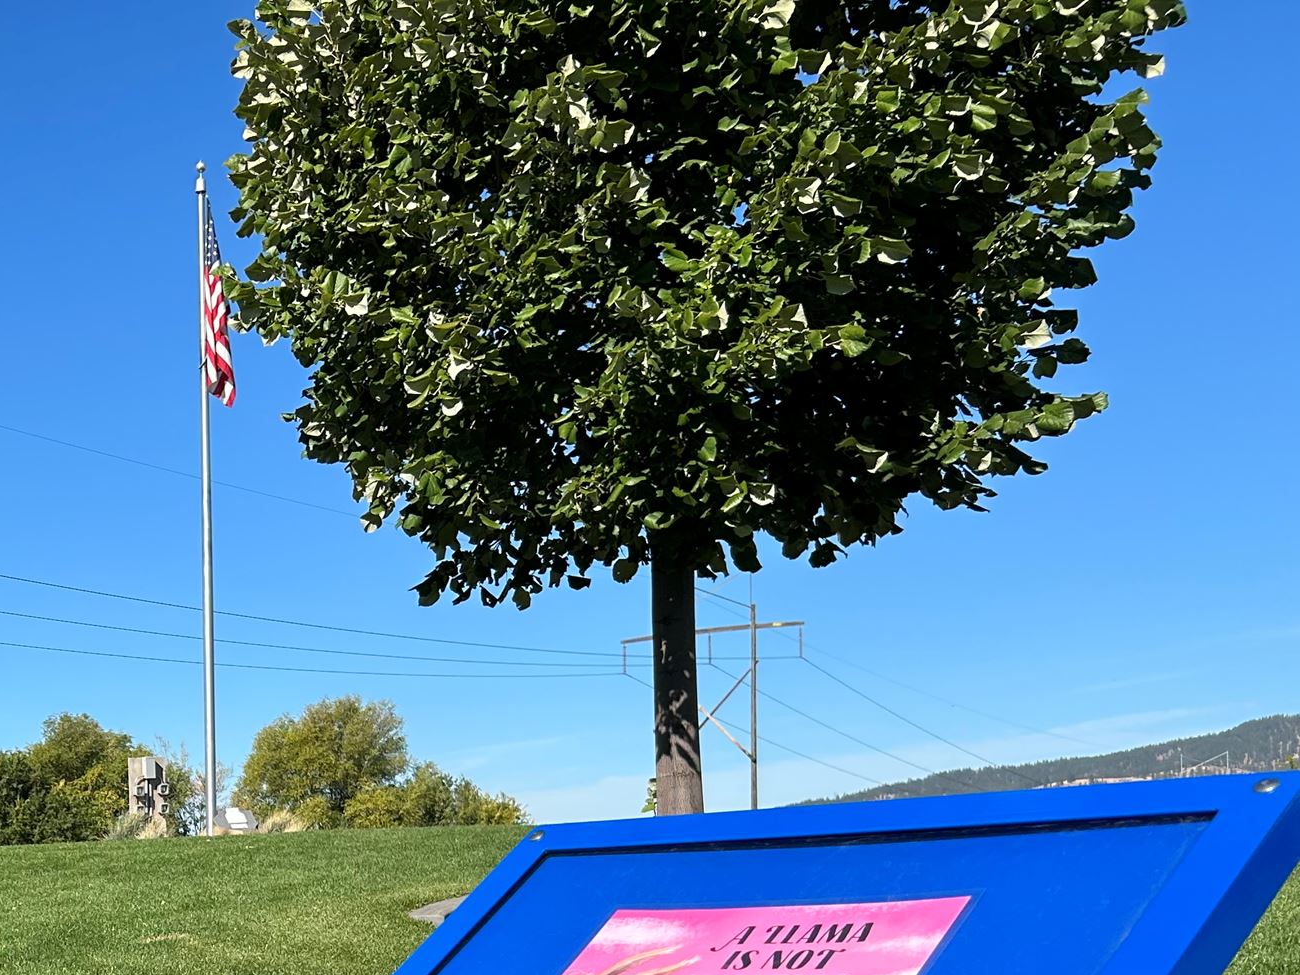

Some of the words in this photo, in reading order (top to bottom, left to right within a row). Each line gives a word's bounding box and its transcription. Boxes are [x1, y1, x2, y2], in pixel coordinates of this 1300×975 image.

[710, 925, 756, 952] A
[764, 922, 873, 944] LLAMA
[720, 950, 759, 970] IS
[760, 948, 846, 970] NOT
